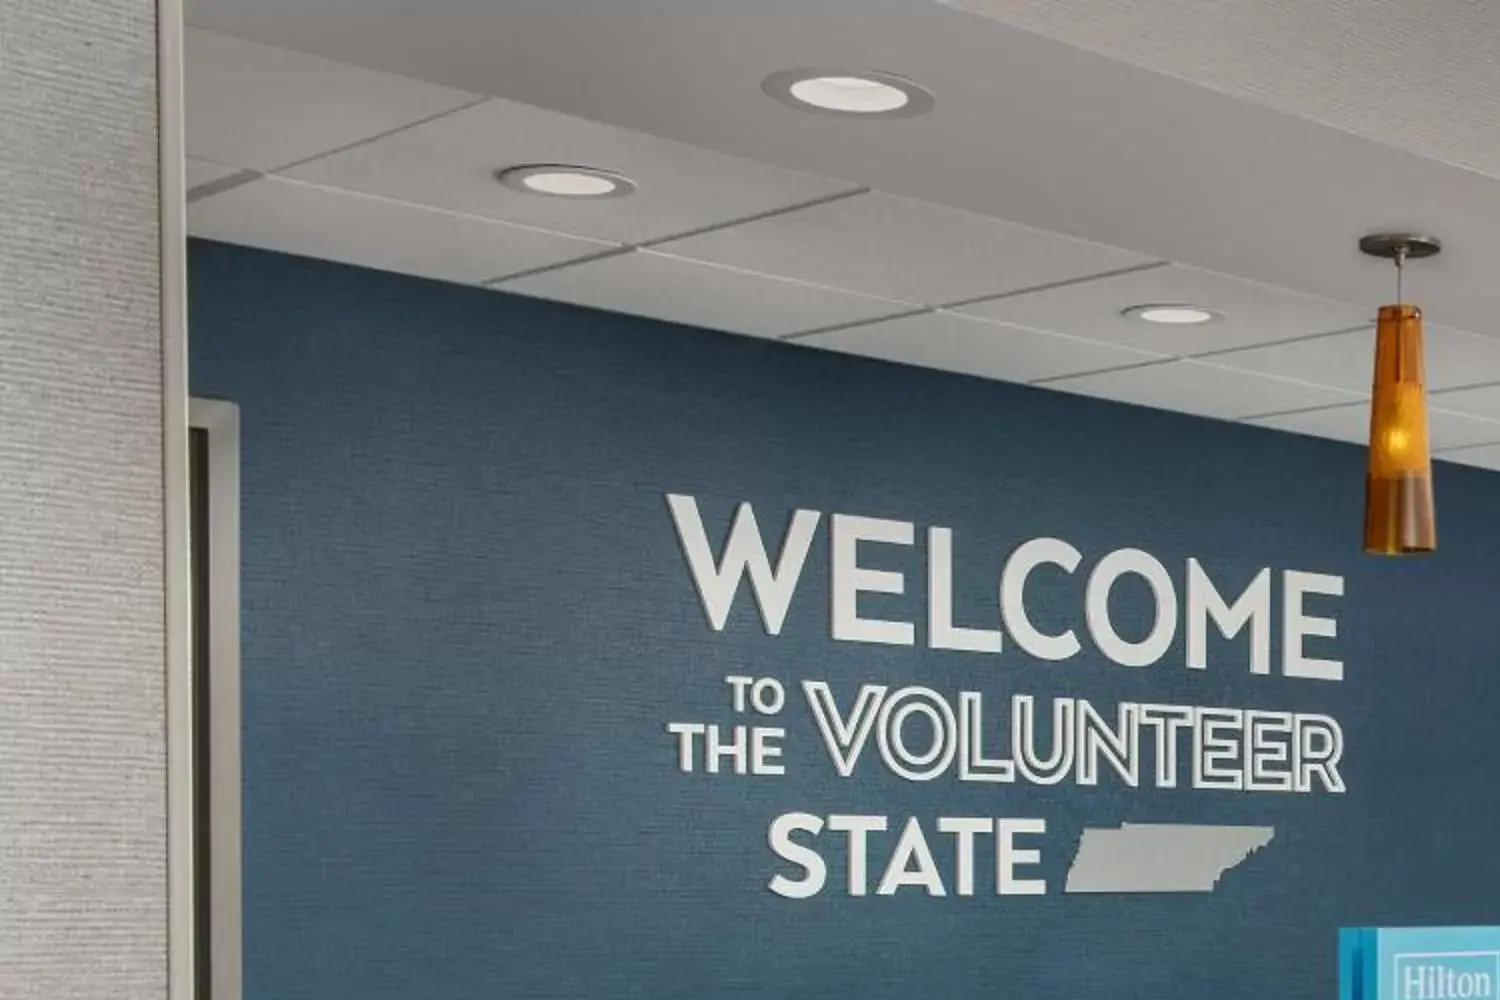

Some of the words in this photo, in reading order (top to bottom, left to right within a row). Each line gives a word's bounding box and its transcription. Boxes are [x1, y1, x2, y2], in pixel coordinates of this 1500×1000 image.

[666, 493, 1345, 681] WELCOME
[667, 722, 786, 775] THE
[802, 679, 1347, 793] VOLUNTEER
[726, 675, 785, 715] TO
[767, 811, 1047, 899] STATE
[1404, 964, 1491, 1000] Hilton
